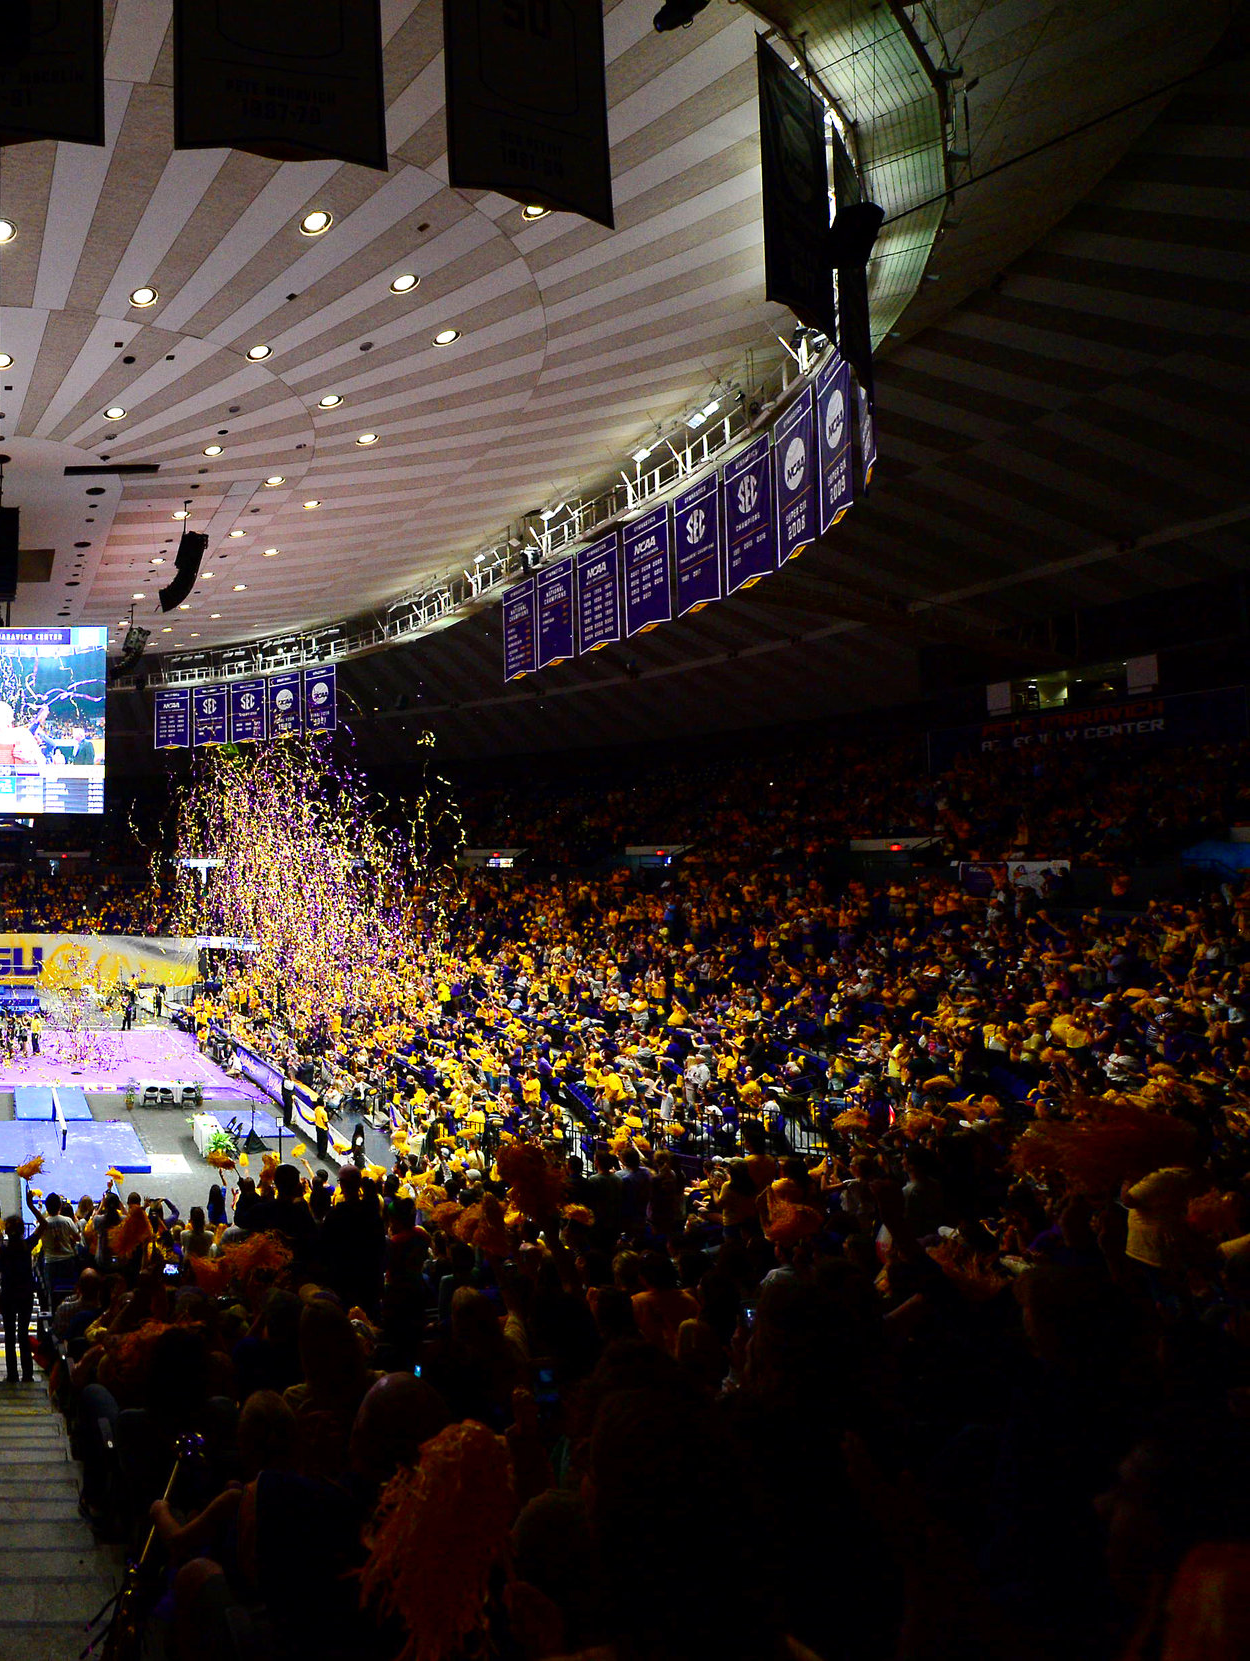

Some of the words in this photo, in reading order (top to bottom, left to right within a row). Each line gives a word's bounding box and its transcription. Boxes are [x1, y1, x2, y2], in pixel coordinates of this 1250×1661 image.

[827, 410, 844, 441] NCAA
[787, 455, 806, 482] NCAA
[737, 474, 758, 514] SEC
[785, 509, 799, 525] SUPER
[798, 499, 808, 514] SIX
[686, 508, 706, 545] SEC
[787, 514, 807, 541] 2008
[633, 535, 656, 556] NCAA
[586, 560, 607, 580] NCAA
[35, 633, 63, 641] CENTER
[202, 698, 217, 714] SEC
[240, 693, 256, 710] SEC
[1083, 718, 1166, 740] CENTER
